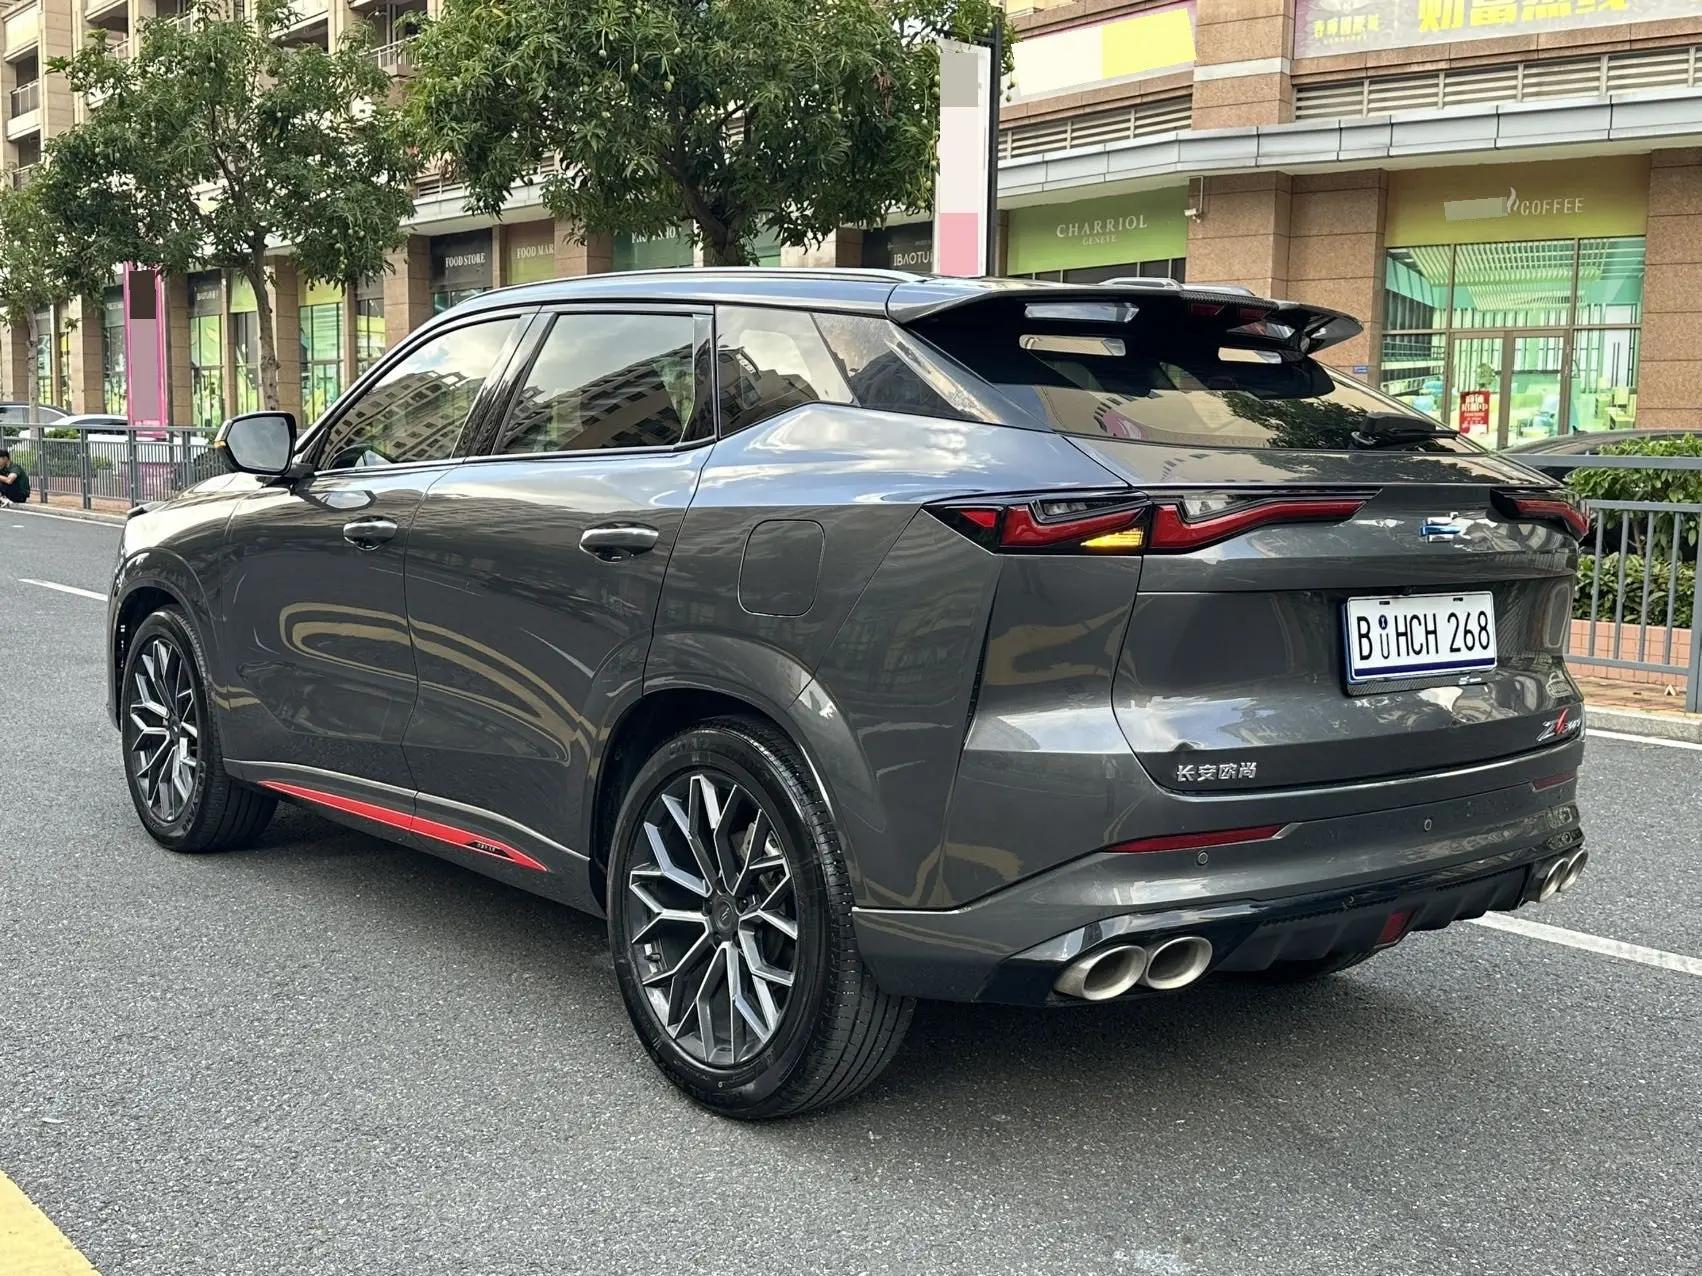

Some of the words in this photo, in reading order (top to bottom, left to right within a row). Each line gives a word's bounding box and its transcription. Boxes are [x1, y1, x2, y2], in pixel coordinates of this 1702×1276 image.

[1521, 198, 1584, 216] COFFEE
[1056, 214, 1148, 238] CHARRIOL
[445, 256, 464, 268] FOOD
[464, 252, 486, 266] STORE
[516, 246, 536, 259] FOOD
[1447, 610, 1490, 653] 268
[1176, 762, 1257, 781] 长安欧尚
